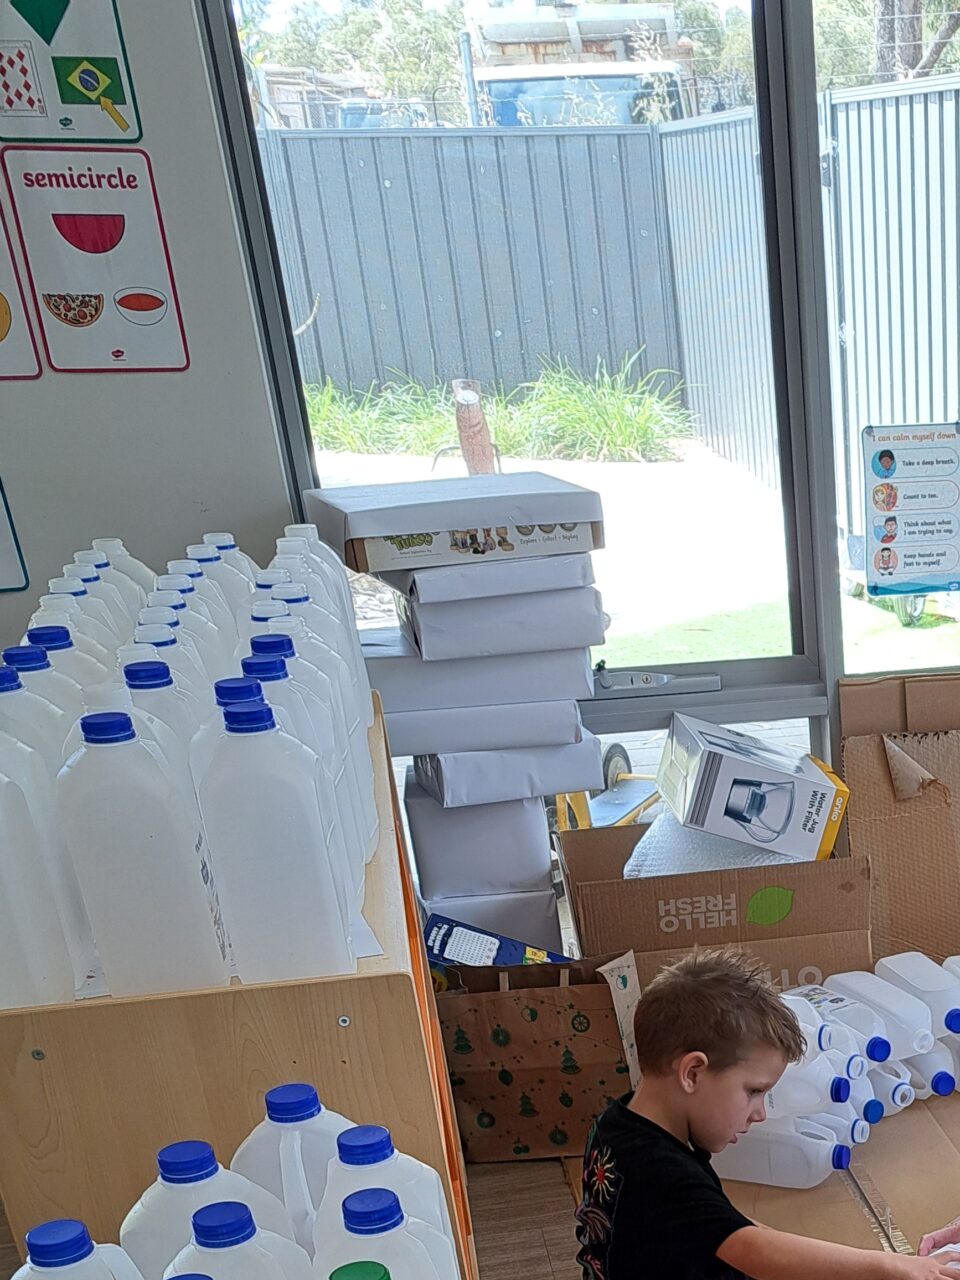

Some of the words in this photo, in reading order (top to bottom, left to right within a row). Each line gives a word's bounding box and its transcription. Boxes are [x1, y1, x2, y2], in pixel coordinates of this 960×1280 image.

[22, 166, 139, 189] semicircle
[892, 433, 910, 441] calm
[911, 431, 935, 443] myself
[936, 431, 957, 440] down
[808, 790, 820, 808] With
[815, 792, 828, 817] Water
[831, 796, 843, 822] anko
[801, 810, 813, 832] Filter
[807, 819, 819, 834] Jug
[657, 893, 737, 916] FRESH
[659, 909, 737, 933] HELLO
